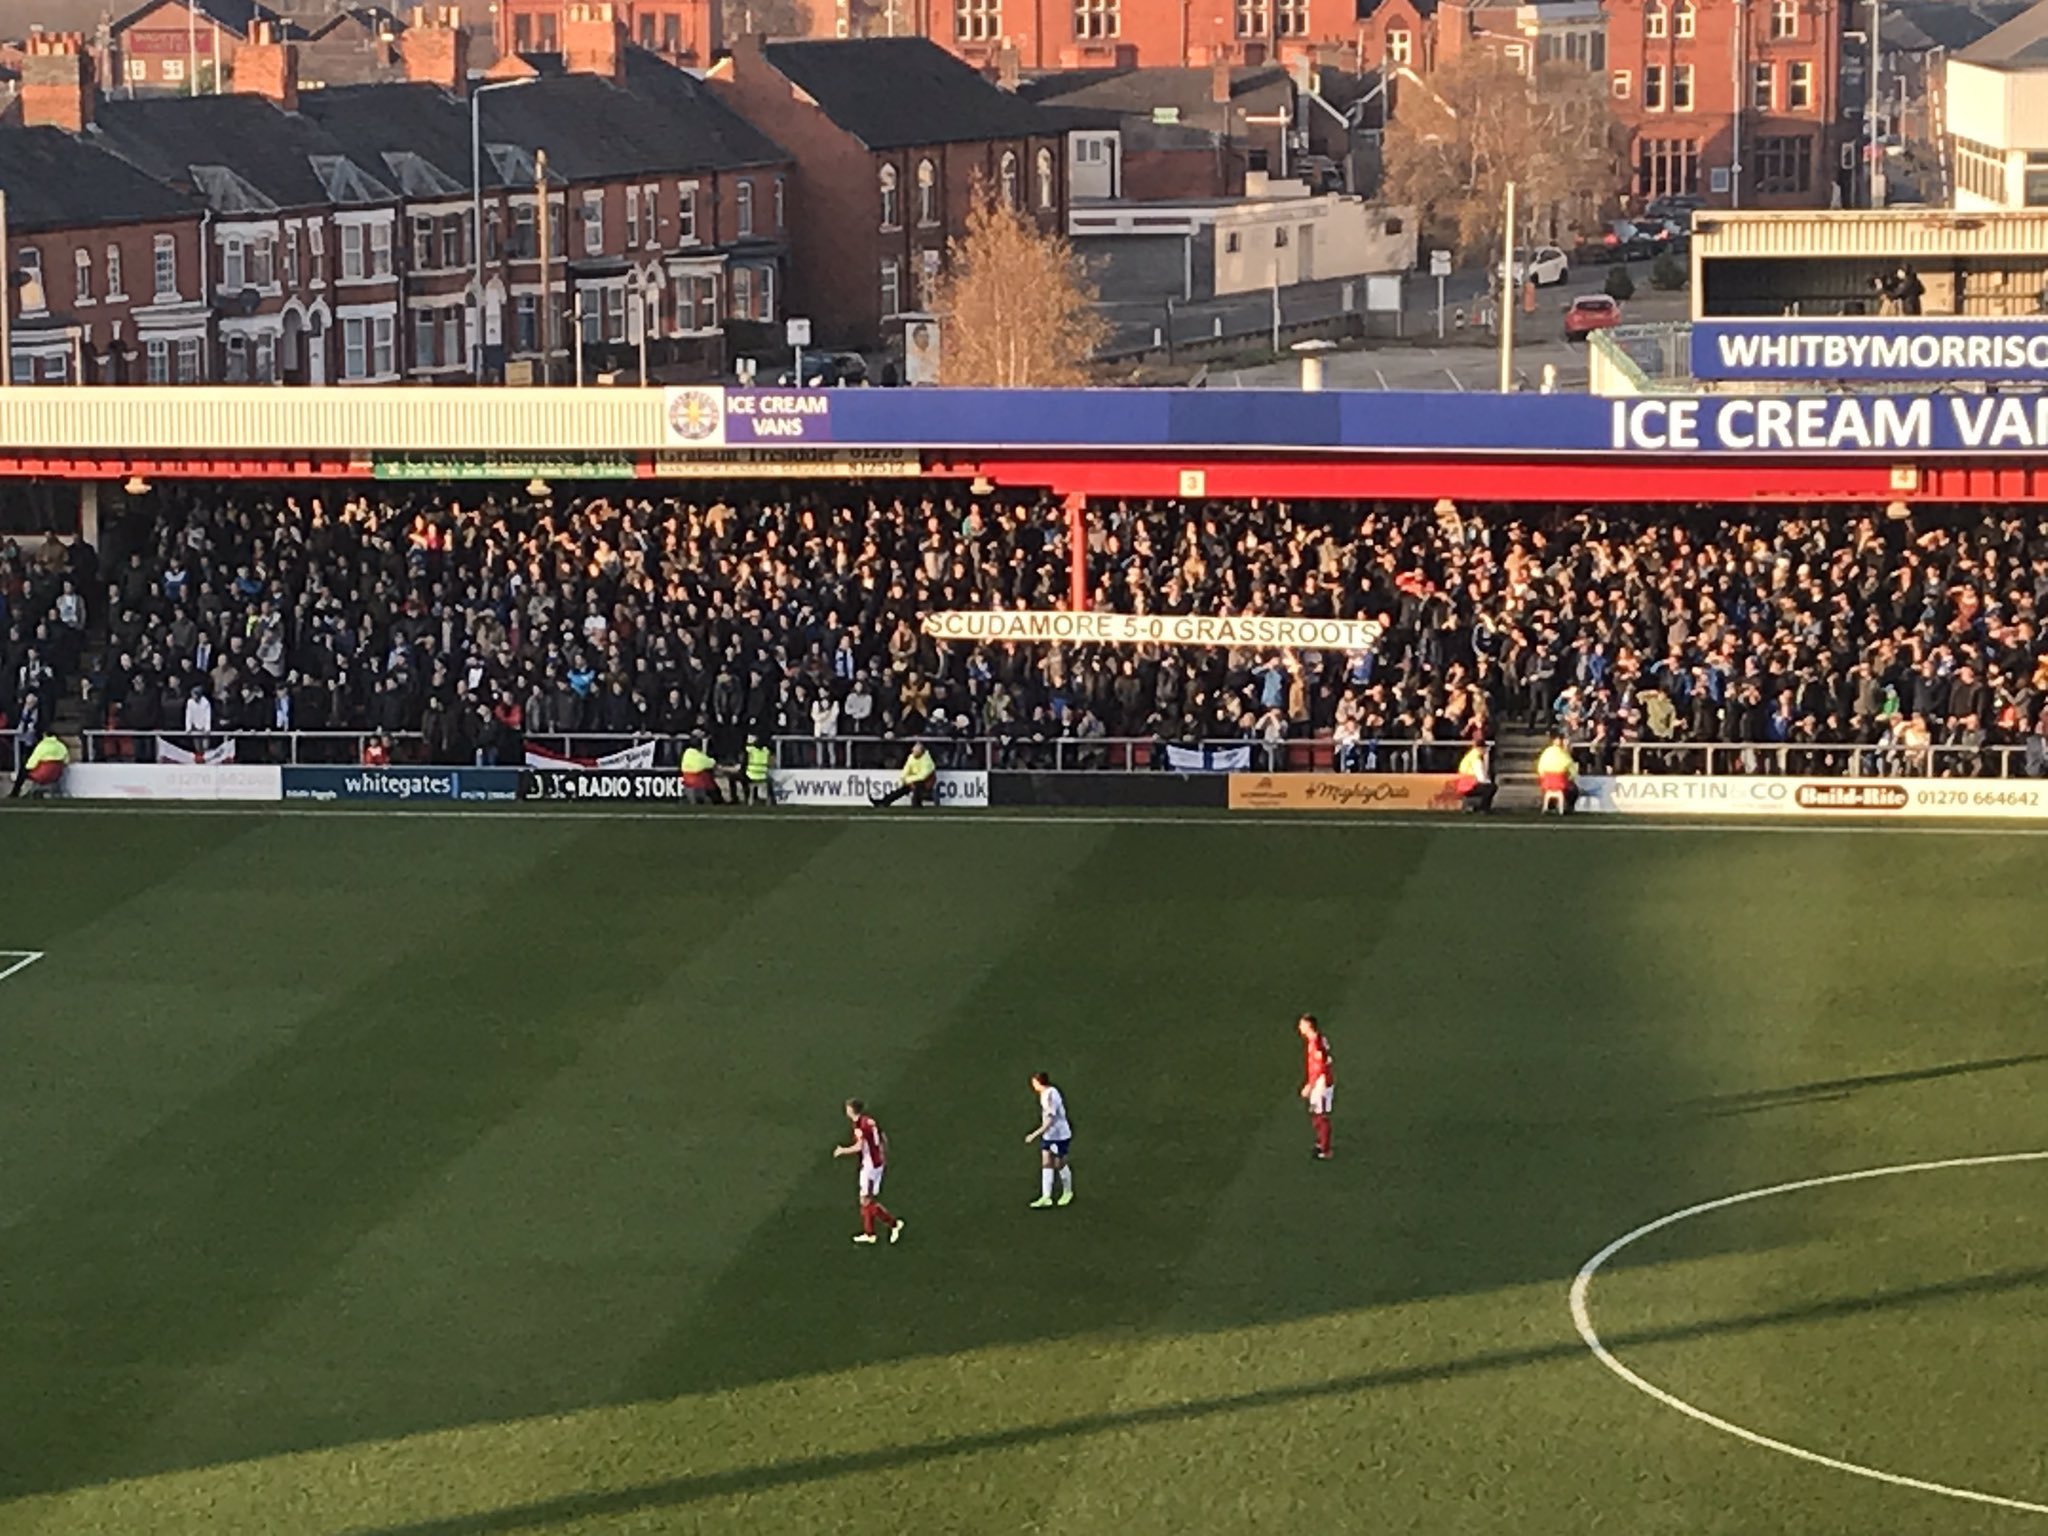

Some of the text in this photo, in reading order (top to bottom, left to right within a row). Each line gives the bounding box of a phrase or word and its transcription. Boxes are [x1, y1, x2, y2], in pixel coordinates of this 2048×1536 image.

[727, 396, 828, 414] ICE CREAM
[752, 418, 803, 436] VANS
[1612, 399, 1699, 448] ICE
[1716, 398, 1931, 448] CREAM
[1187, 476, 1198, 490] 3
[926, 612, 1378, 646] SCUDAMORE 5-0 GRASSROOTS
[345, 773, 450, 798] whitegates
[578, 776, 631, 797] RADIO
[1615, 782, 1727, 799] MARTIN
[1750, 782, 1788, 800] CO
[1917, 790, 2039, 807] 01270 664642
